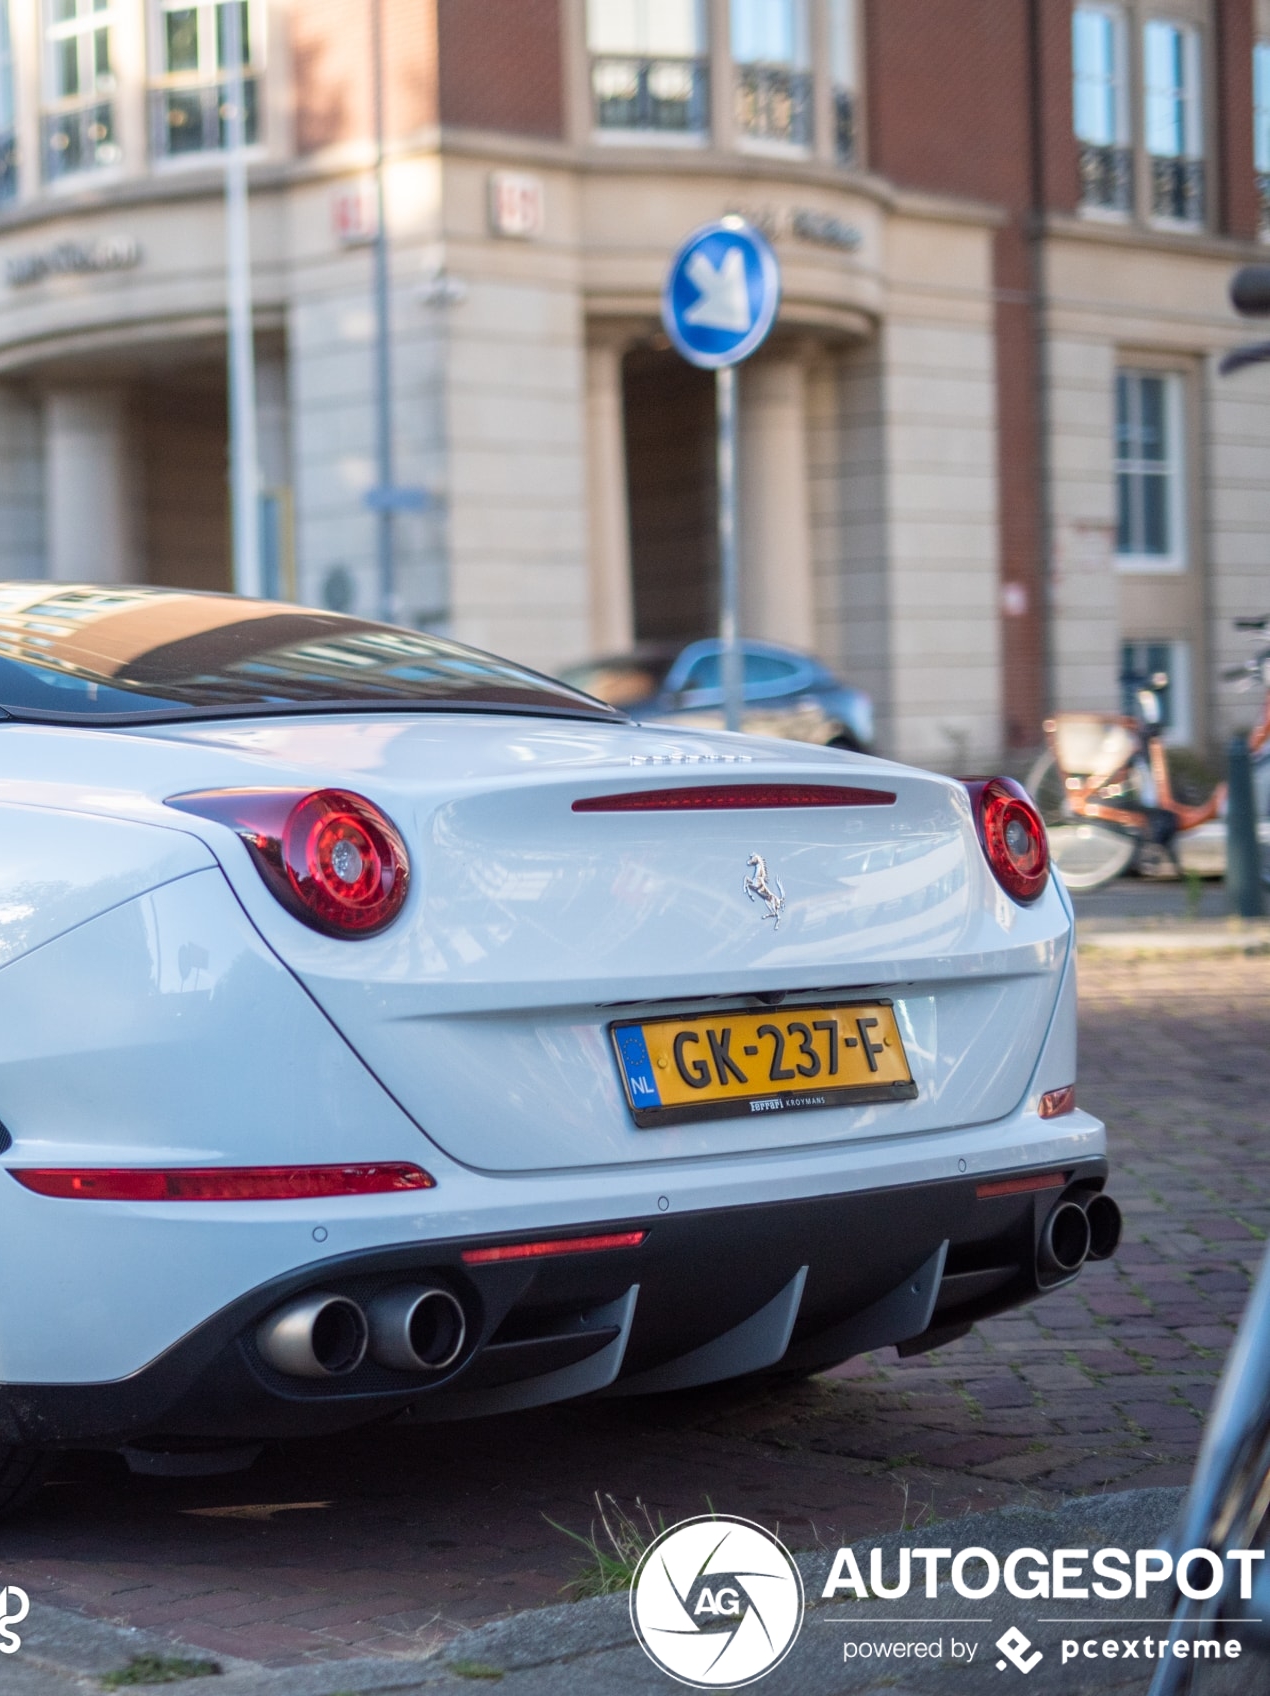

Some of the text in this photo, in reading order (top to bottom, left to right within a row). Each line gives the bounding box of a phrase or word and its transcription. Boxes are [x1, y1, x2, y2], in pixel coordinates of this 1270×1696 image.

[673, 1018, 883, 1088] GK-237-F
[630, 1076, 655, 1095] NL
[785, 1096, 826, 1107] KROYMANS
